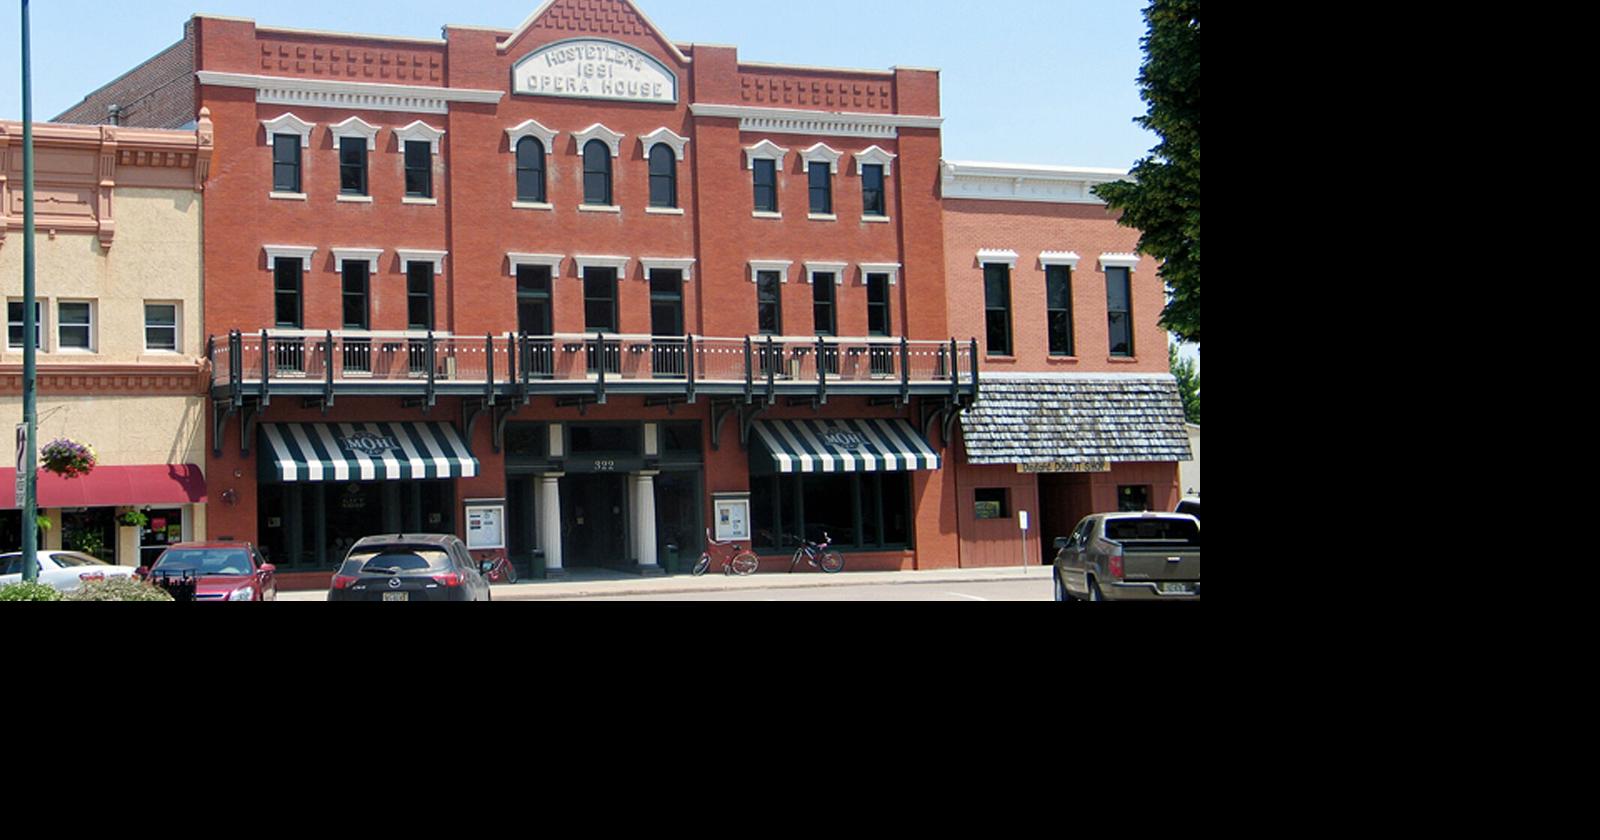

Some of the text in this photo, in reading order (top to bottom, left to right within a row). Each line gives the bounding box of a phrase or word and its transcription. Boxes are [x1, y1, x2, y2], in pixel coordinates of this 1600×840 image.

[527, 75, 663, 97] OPERA HOUSE
[594, 460, 614, 470] 322
